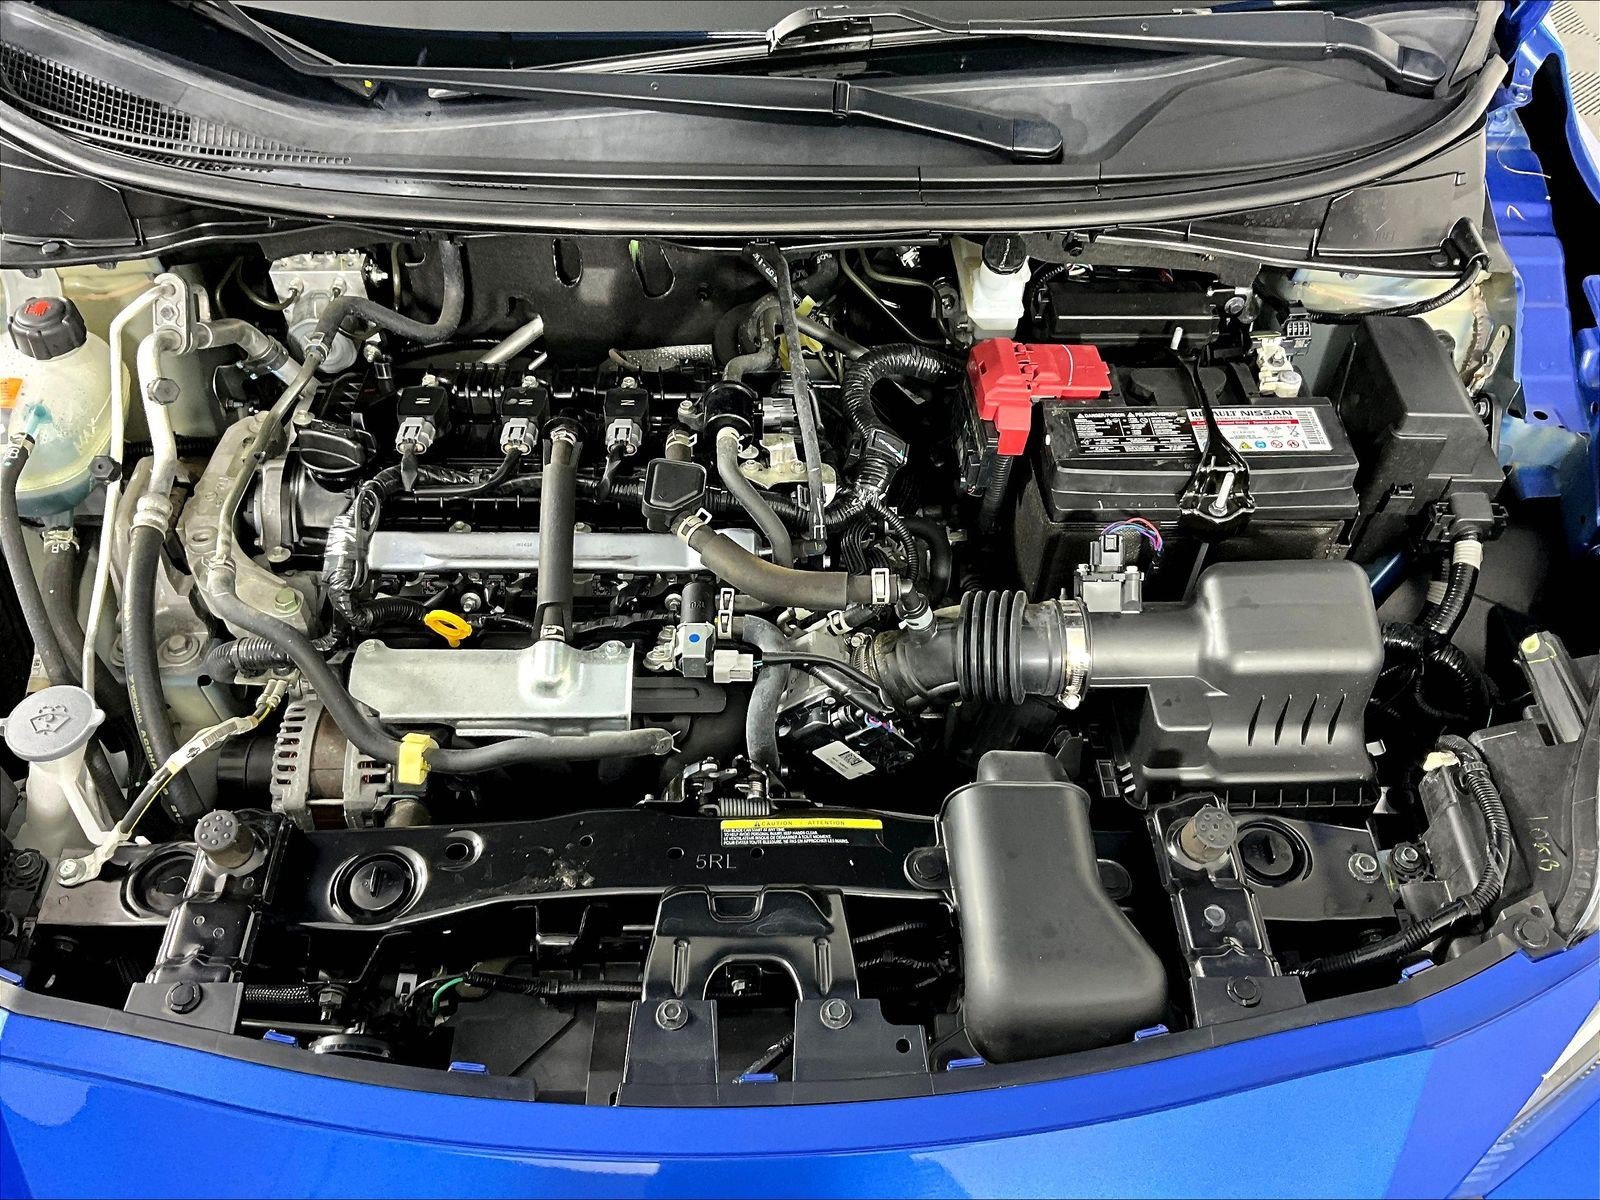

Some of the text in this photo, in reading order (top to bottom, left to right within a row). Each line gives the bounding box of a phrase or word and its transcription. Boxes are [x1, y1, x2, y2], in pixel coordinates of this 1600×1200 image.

[1240, 409, 1293, 417] NISSAN
[131, 684, 143, 724] YOKOHAMA
[696, 854, 736, 870] 5RL
